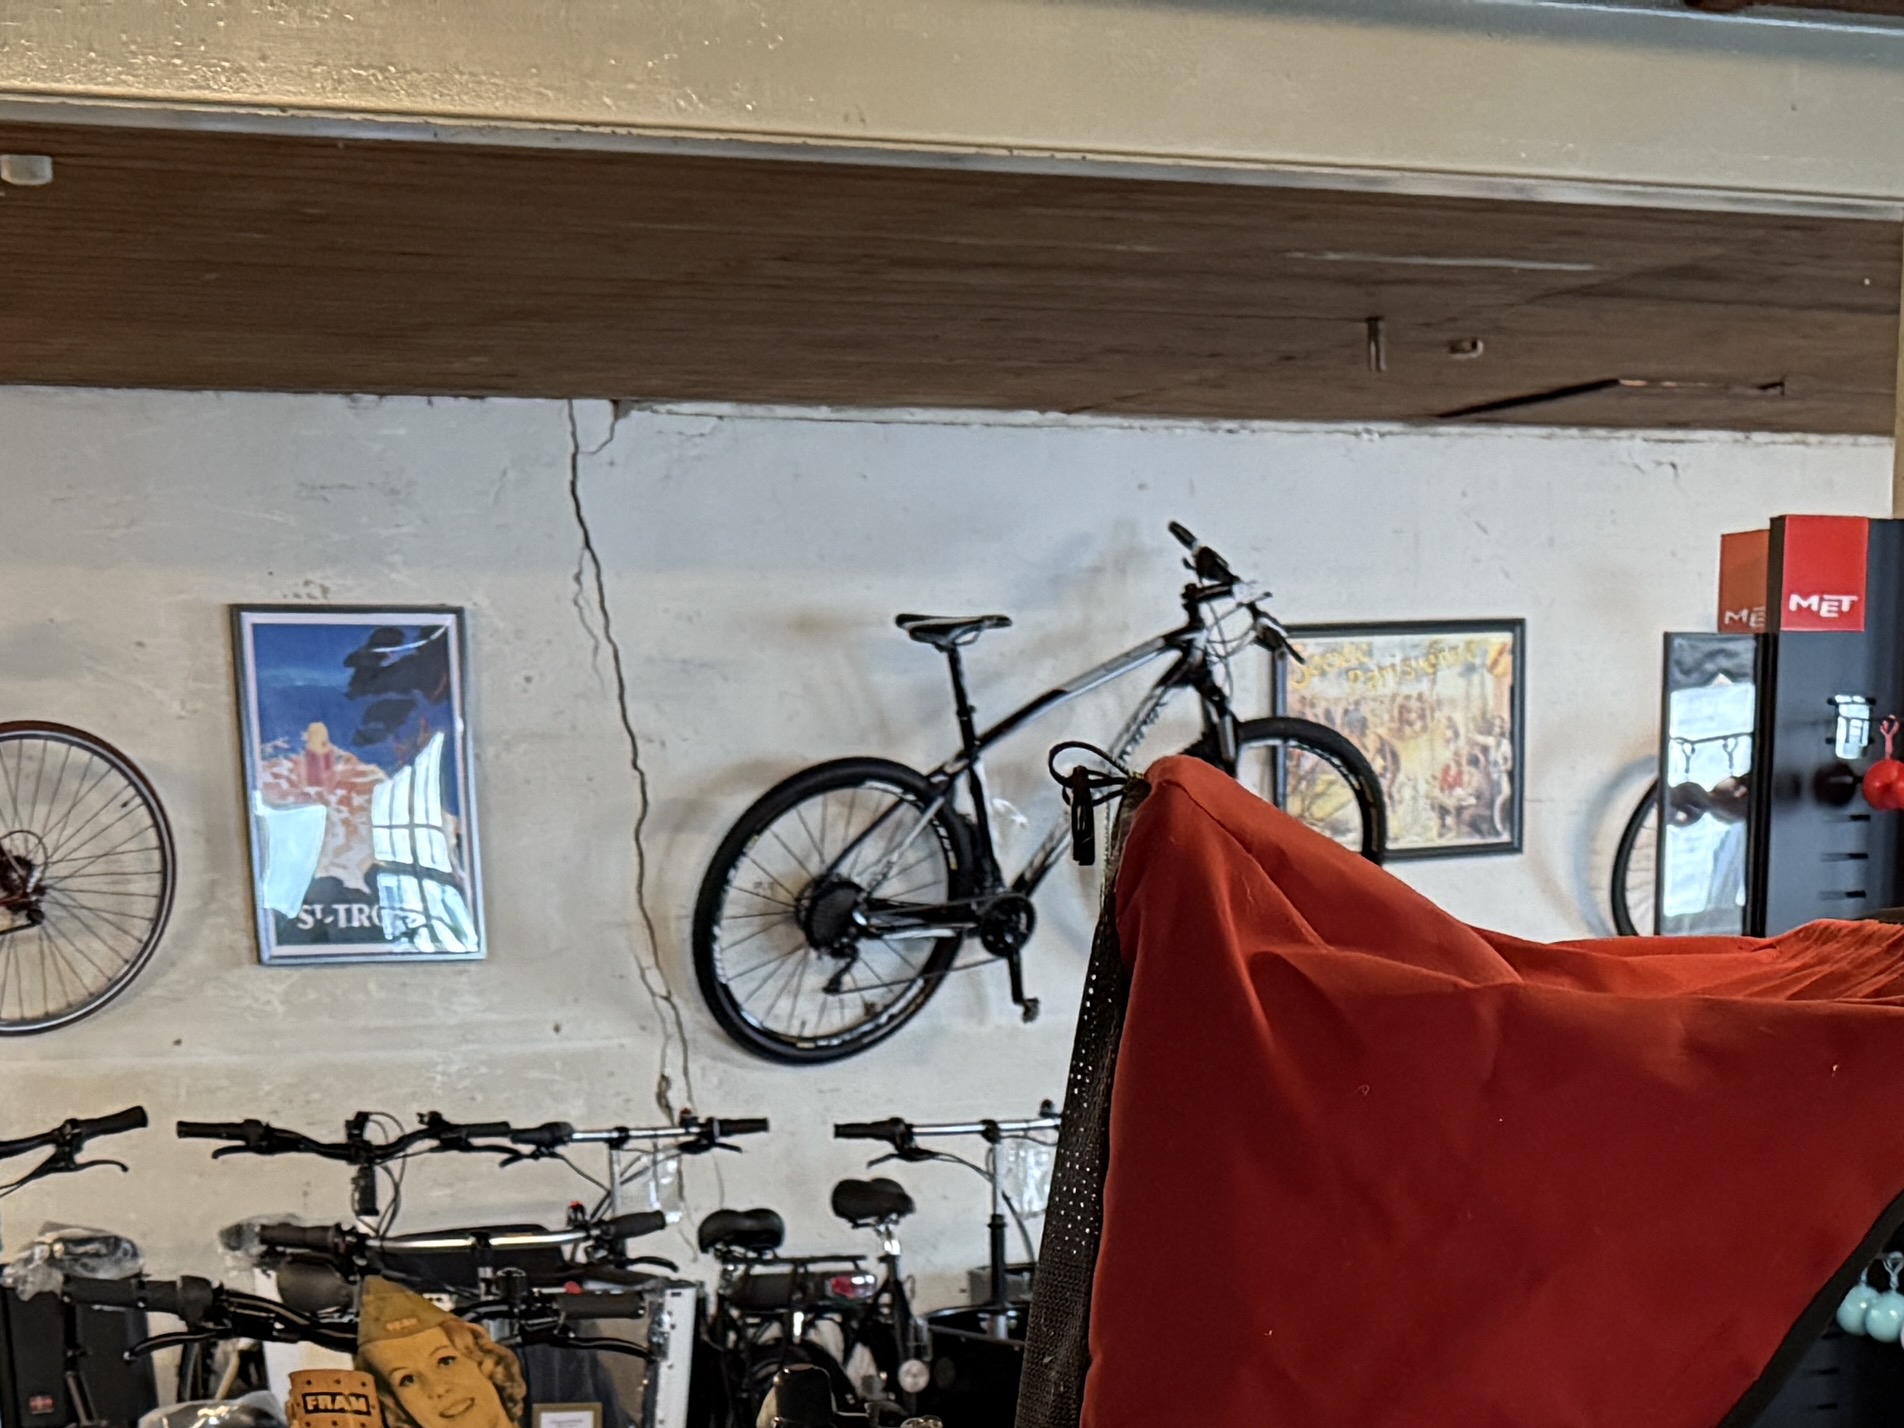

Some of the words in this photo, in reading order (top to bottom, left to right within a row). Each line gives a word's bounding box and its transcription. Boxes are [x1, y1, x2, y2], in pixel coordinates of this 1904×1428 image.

[1788, 593, 1859, 618] MET
[1724, 606, 1767, 628] ME
[304, 1394, 369, 1413] FRAM
